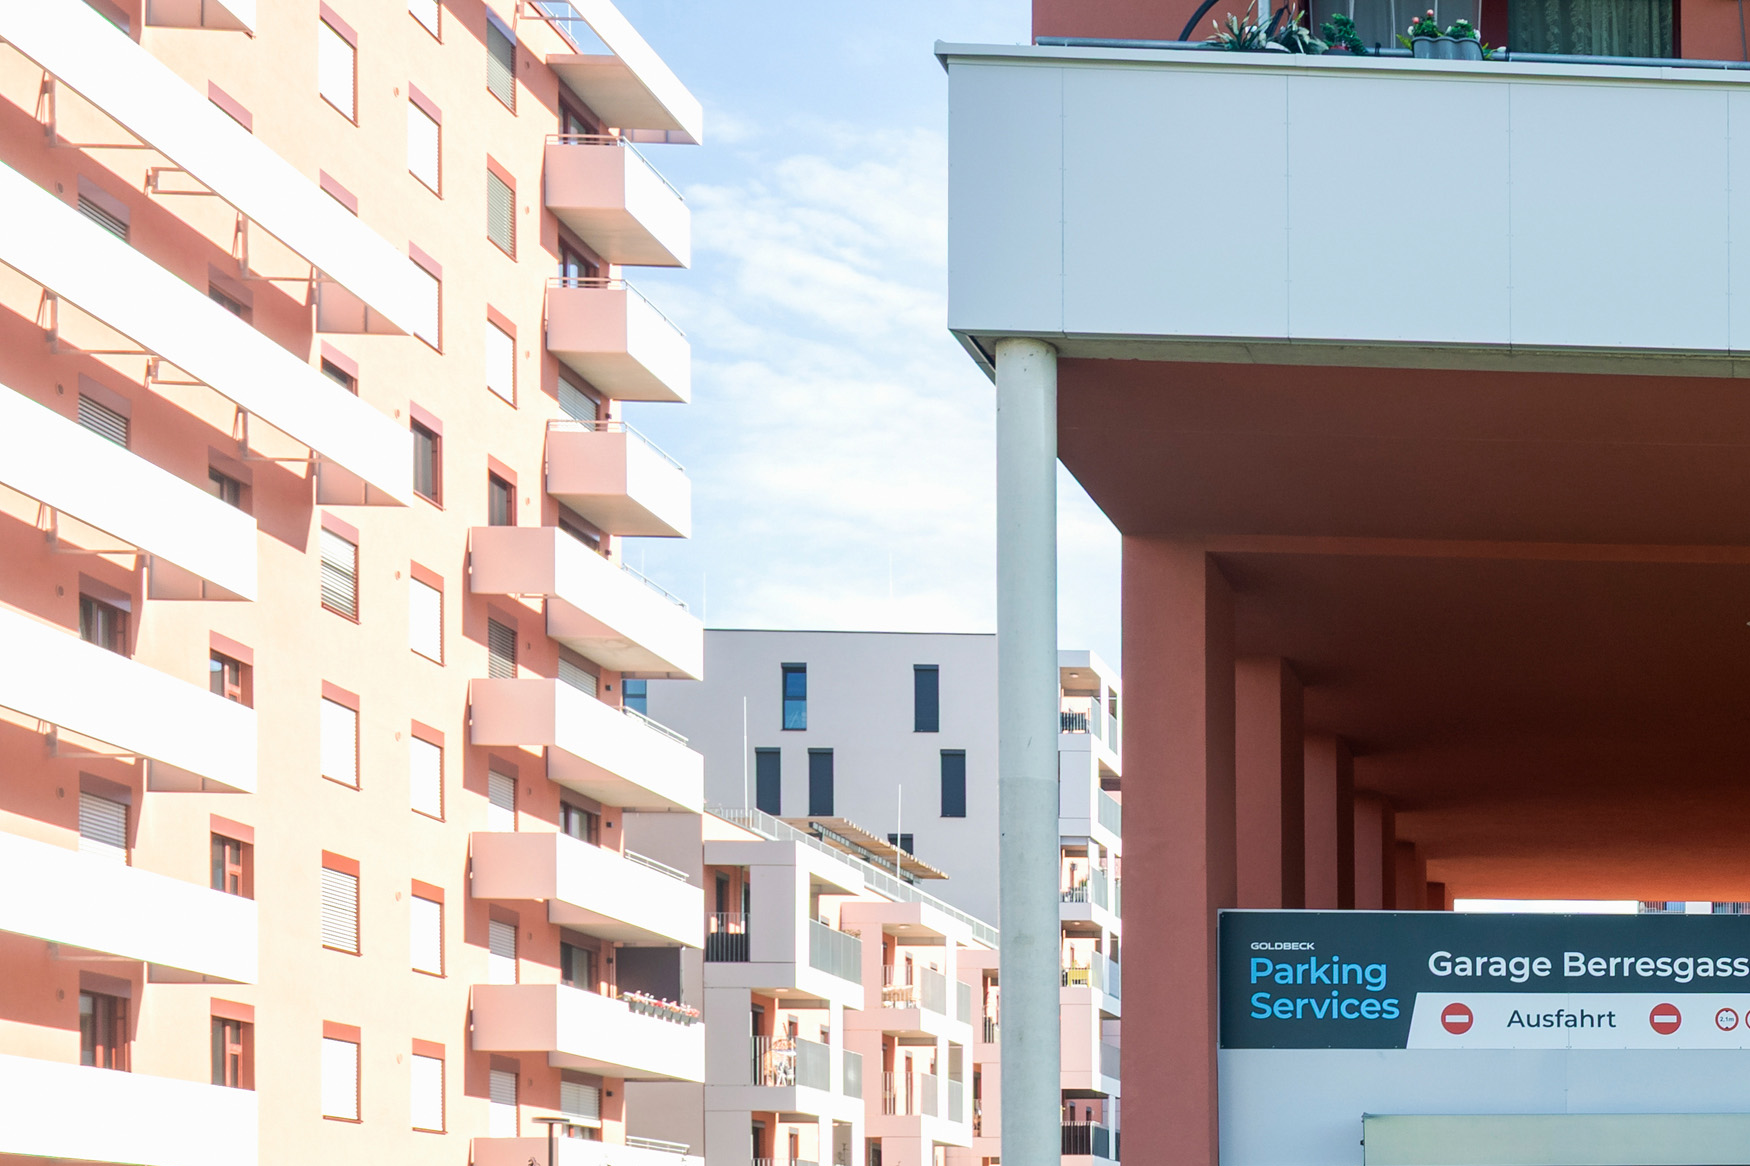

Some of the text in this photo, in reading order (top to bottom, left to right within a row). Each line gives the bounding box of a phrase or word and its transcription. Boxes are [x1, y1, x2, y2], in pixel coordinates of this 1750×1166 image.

[1250, 941, 1315, 951] GOLDBECK
[1250, 955, 1387, 992] Parking
[1428, 950, 1552, 984] Garage
[1250, 991, 1400, 1020] Services
[1506, 1008, 1617, 1028] Ausfahrt
